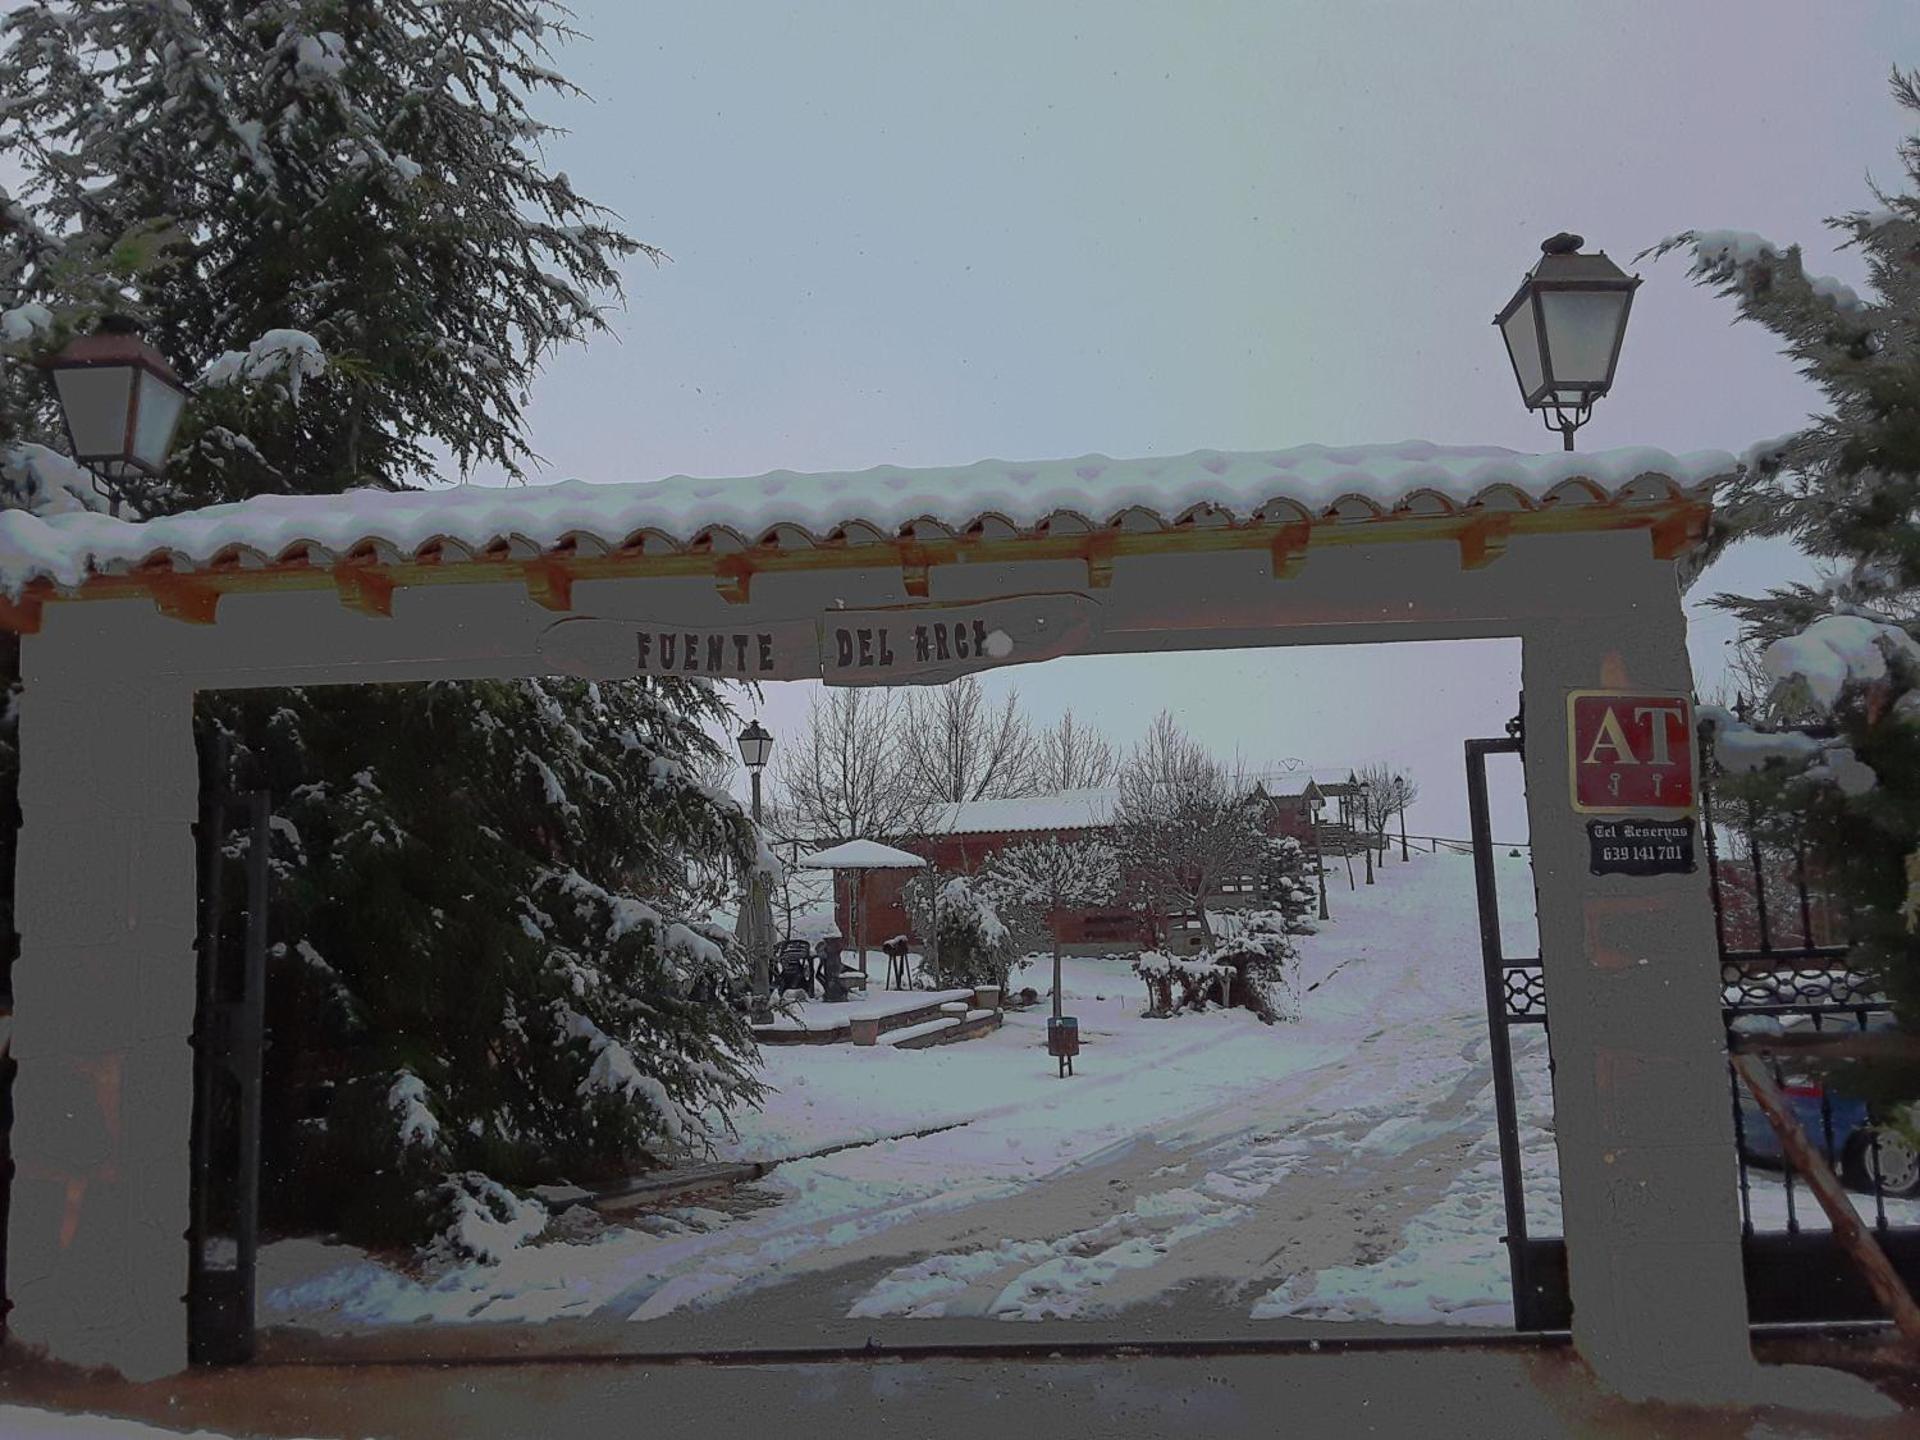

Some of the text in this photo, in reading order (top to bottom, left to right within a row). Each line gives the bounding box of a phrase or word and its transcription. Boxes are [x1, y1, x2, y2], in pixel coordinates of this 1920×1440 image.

[636, 631, 775, 672] FUENTE
[836, 628, 894, 667] DEL
[1582, 706, 1683, 765] AT
[1594, 824, 1688, 842] Tel Reservas
[1603, 845, 1682, 860] 639 141 701
